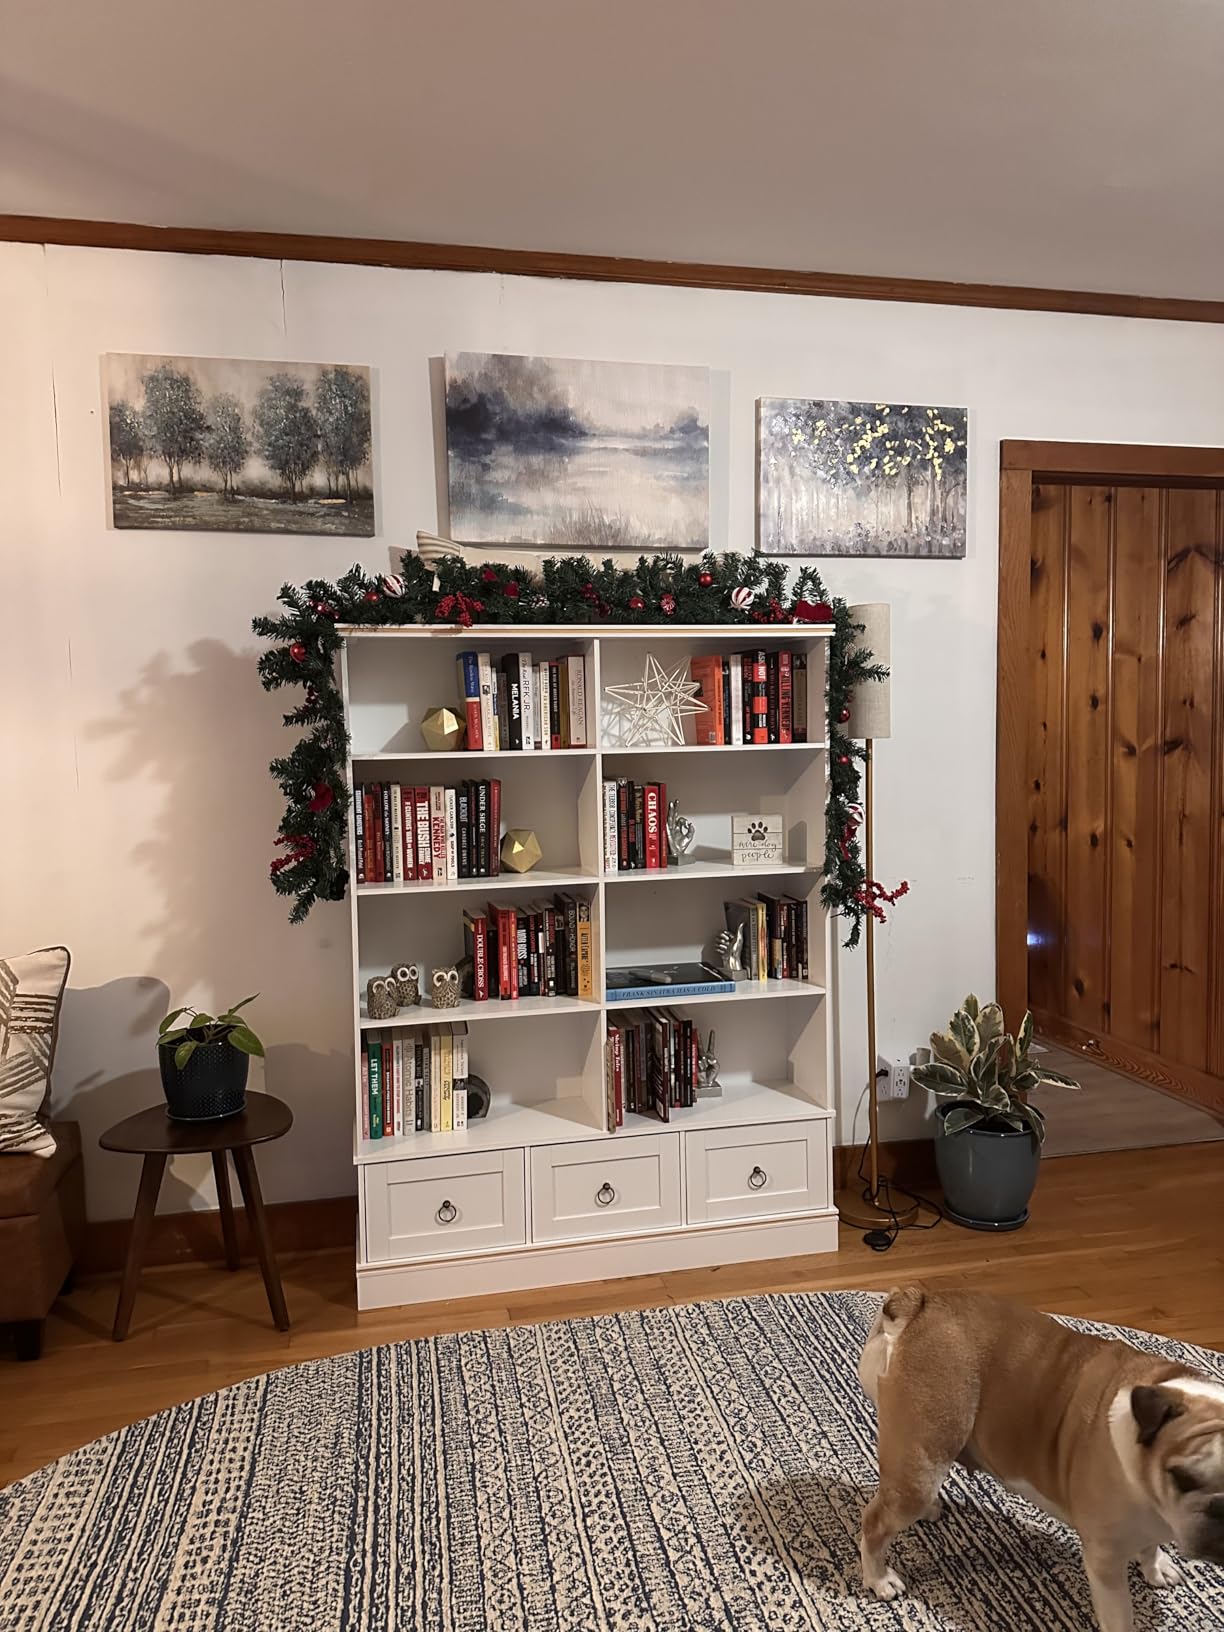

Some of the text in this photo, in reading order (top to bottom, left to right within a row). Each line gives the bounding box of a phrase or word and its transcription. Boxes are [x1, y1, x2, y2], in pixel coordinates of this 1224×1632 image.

[758, 652, 766, 665] ASK
[758, 666, 767, 680] NOT
[511, 684, 520, 720] MELANIA
[648, 793, 657, 833] CHAOS
[417, 801, 430, 848] THE BUSH
[433, 817, 441, 859] KENNEDY
[761, 839, 777, 853] dog
[741, 849, 775, 863] people
[517, 930, 527, 944] MOB
[518, 944, 528, 960] BOSS
[581, 946, 589, 960] CAPONE
[623, 988, 645, 998] FRANK
[646, 986, 676, 996] SINATRA
[677, 986, 691, 994] HAS
[697, 984, 717, 992] COLD
[371, 1073, 379, 1095] THEM
[405, 1056, 414, 1117] Atomic Habits
